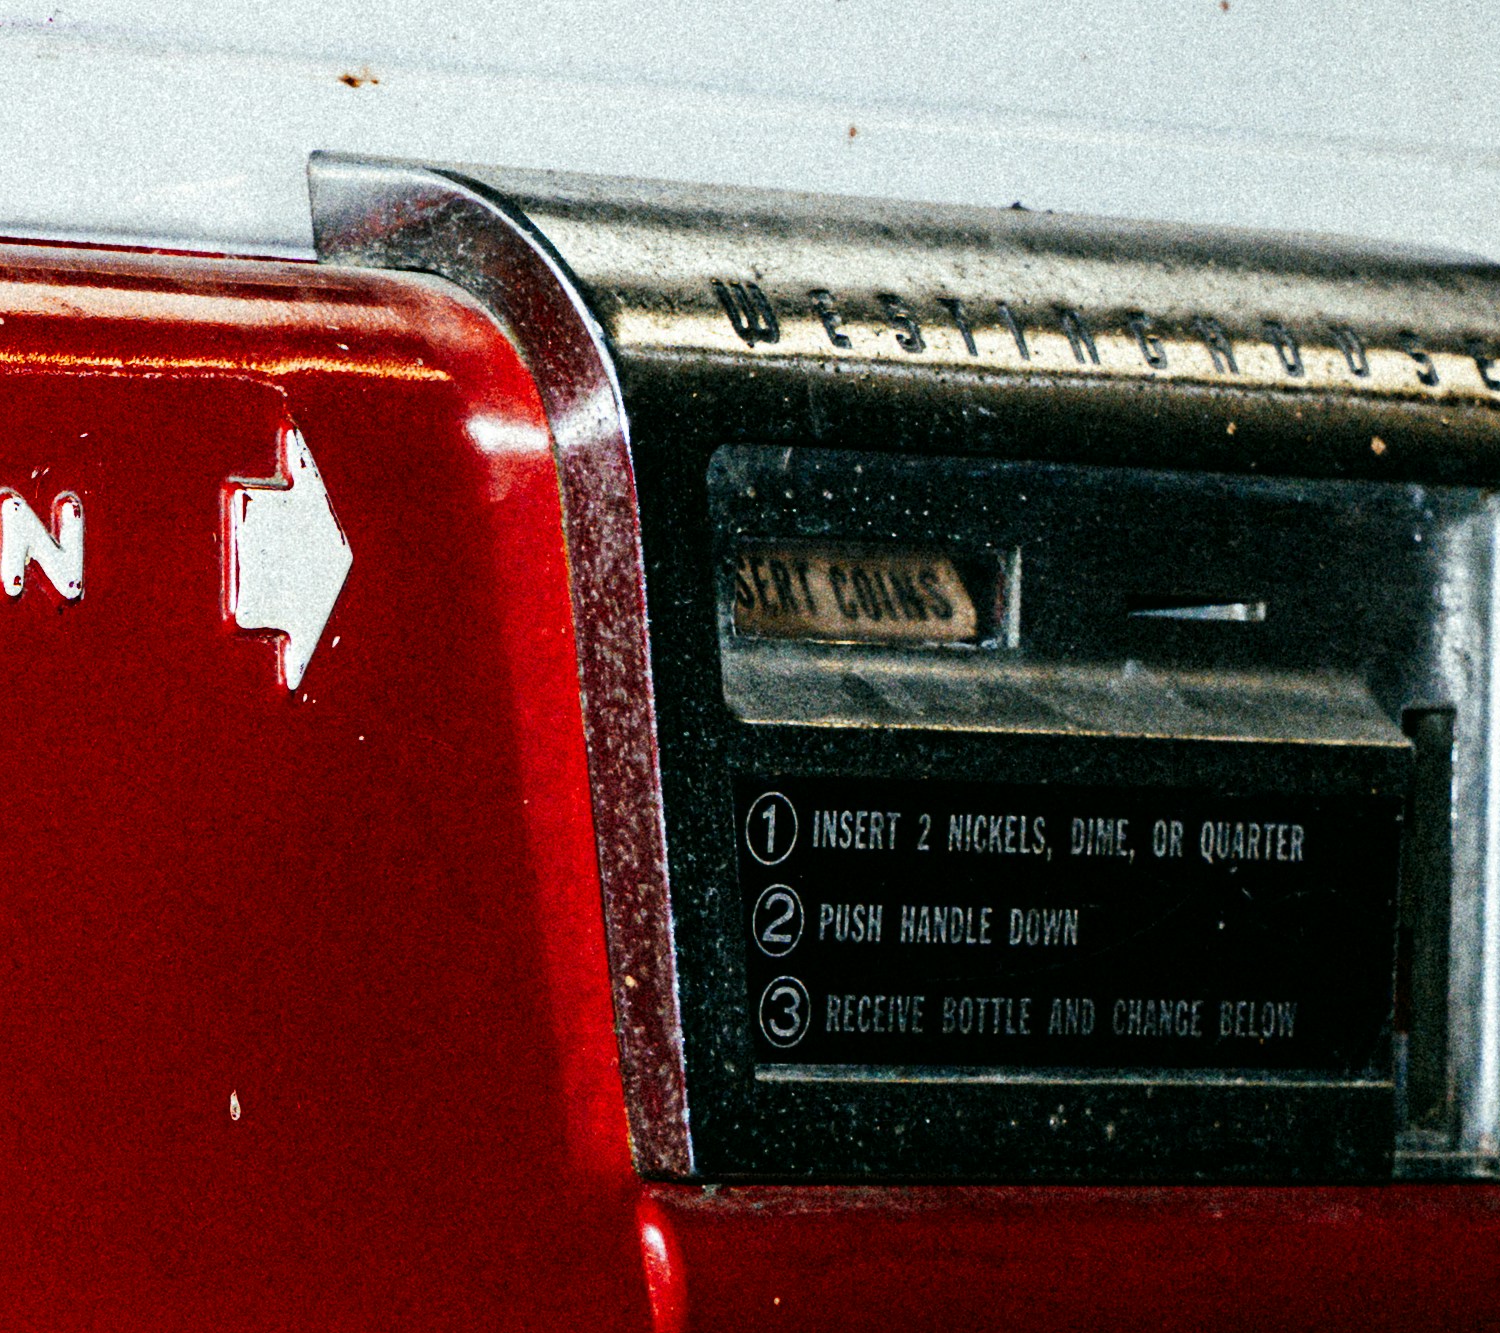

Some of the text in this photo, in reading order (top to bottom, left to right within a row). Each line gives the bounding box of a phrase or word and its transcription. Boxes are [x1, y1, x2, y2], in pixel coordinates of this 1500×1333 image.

[828, 563, 955, 623] COINS
[812, 809, 902, 851] INSERT
[916, 813, 931, 852] 2
[948, 813, 1053, 862] NICKELS,
[1070, 816, 1136, 865] DIME,
[1152, 818, 1184, 860] OR
[1200, 820, 1305, 864] QUARTER
[818, 903, 883, 943] PUSH
[900, 904, 993, 945] HANDLE
[1009, 906, 1080, 947] DOWN
[825, 993, 926, 1035] RECEIVE
[941, 994, 1032, 1036] BOTTLE
[1047, 996, 1096, 1037] AND
[1111, 998, 1203, 1038] CHANGE
[1219, 999, 1299, 1040] BELOW
